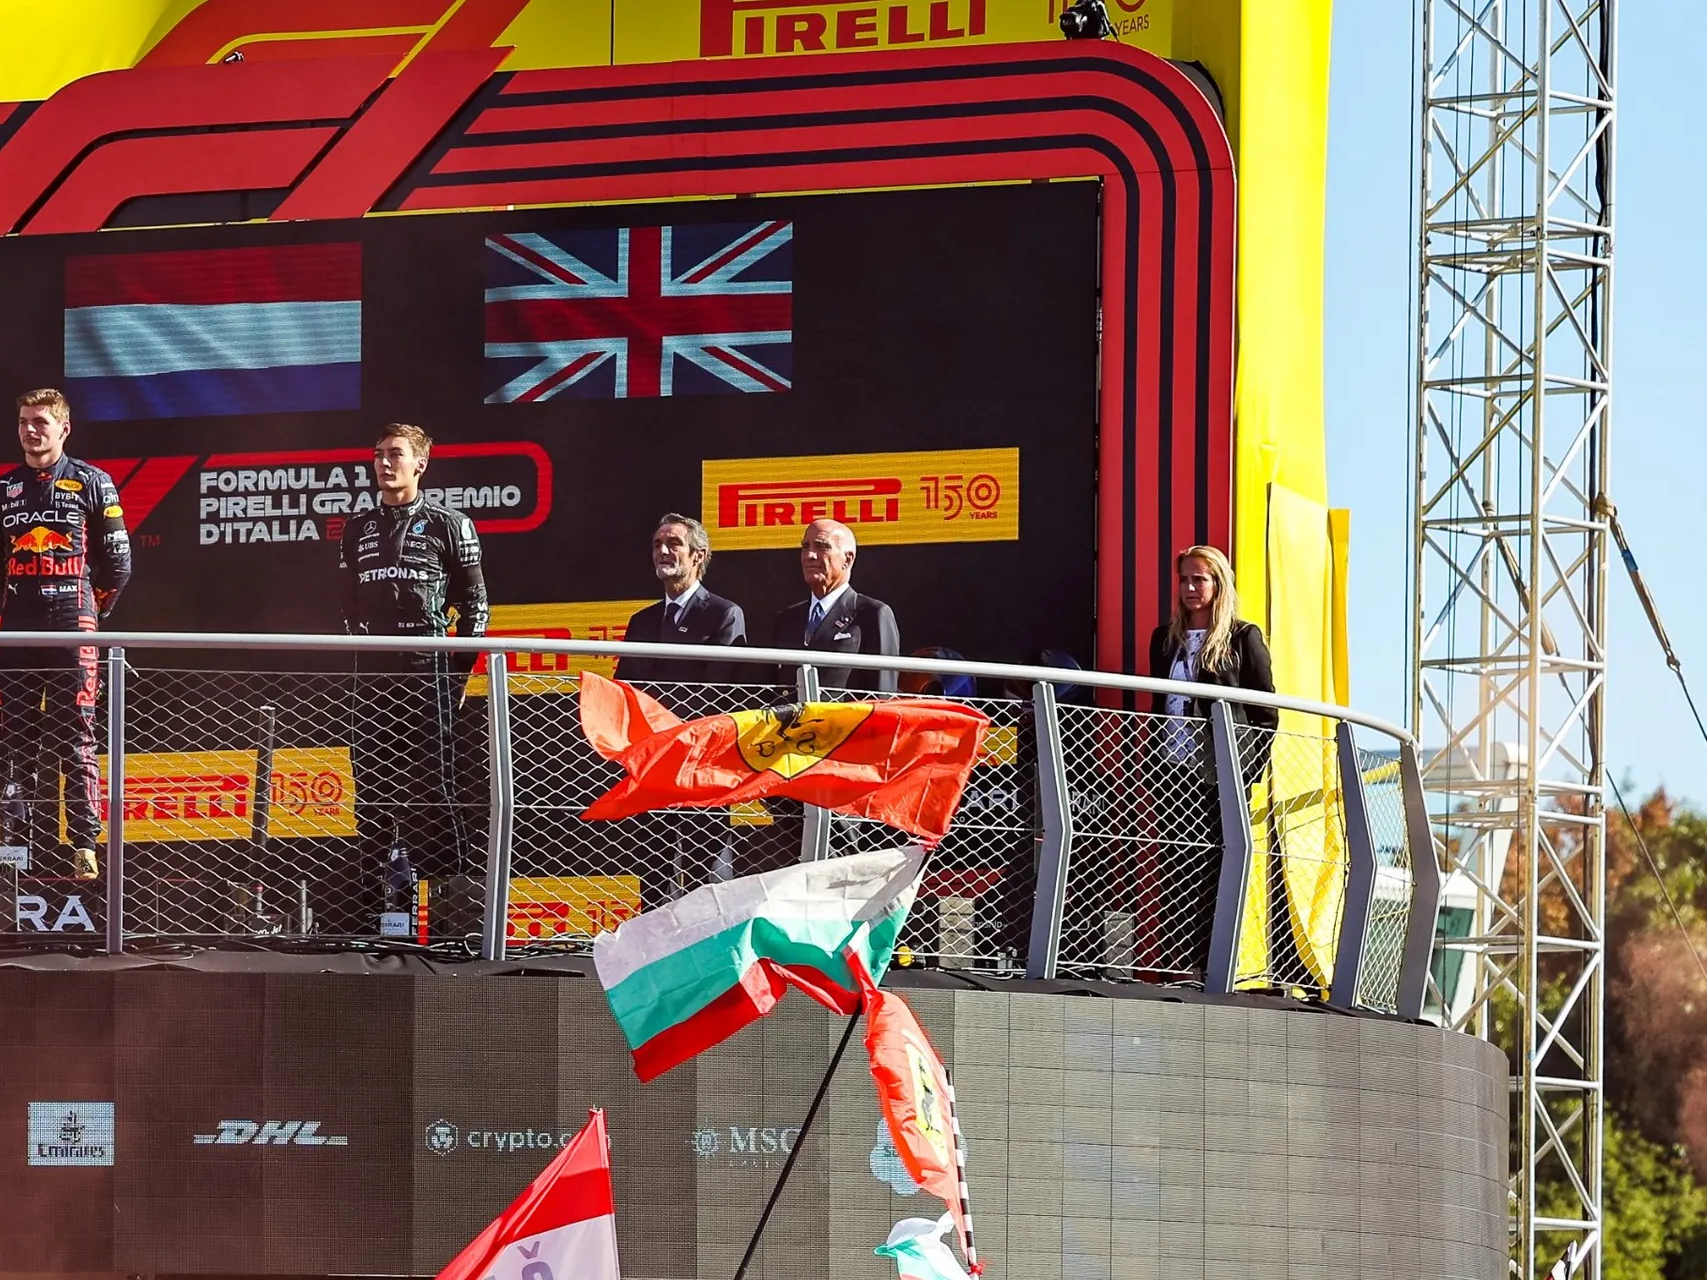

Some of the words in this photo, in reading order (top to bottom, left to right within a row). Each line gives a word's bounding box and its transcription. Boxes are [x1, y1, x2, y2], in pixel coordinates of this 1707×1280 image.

[1115, 14, 1150, 36] YEARS
[200, 467, 348, 494] FORMULA
[354, 466, 371, 487] 1
[200, 495, 307, 519] PIRELLI
[718, 478, 902, 528] PIRELLI
[920, 474, 1001, 520] 150
[3, 510, 79, 528] ORACLE
[969, 510, 998, 519] YEARS
[200, 519, 320, 545] D'ITALIA
[7, 556, 38, 576] Red
[358, 566, 429, 584] PETRONAS
[59, 585, 78, 593] MAX
[410, 867, 419, 936] FERRARI
[213, 1119, 326, 1145] DHL
[729, 1126, 803, 1154] MSC
